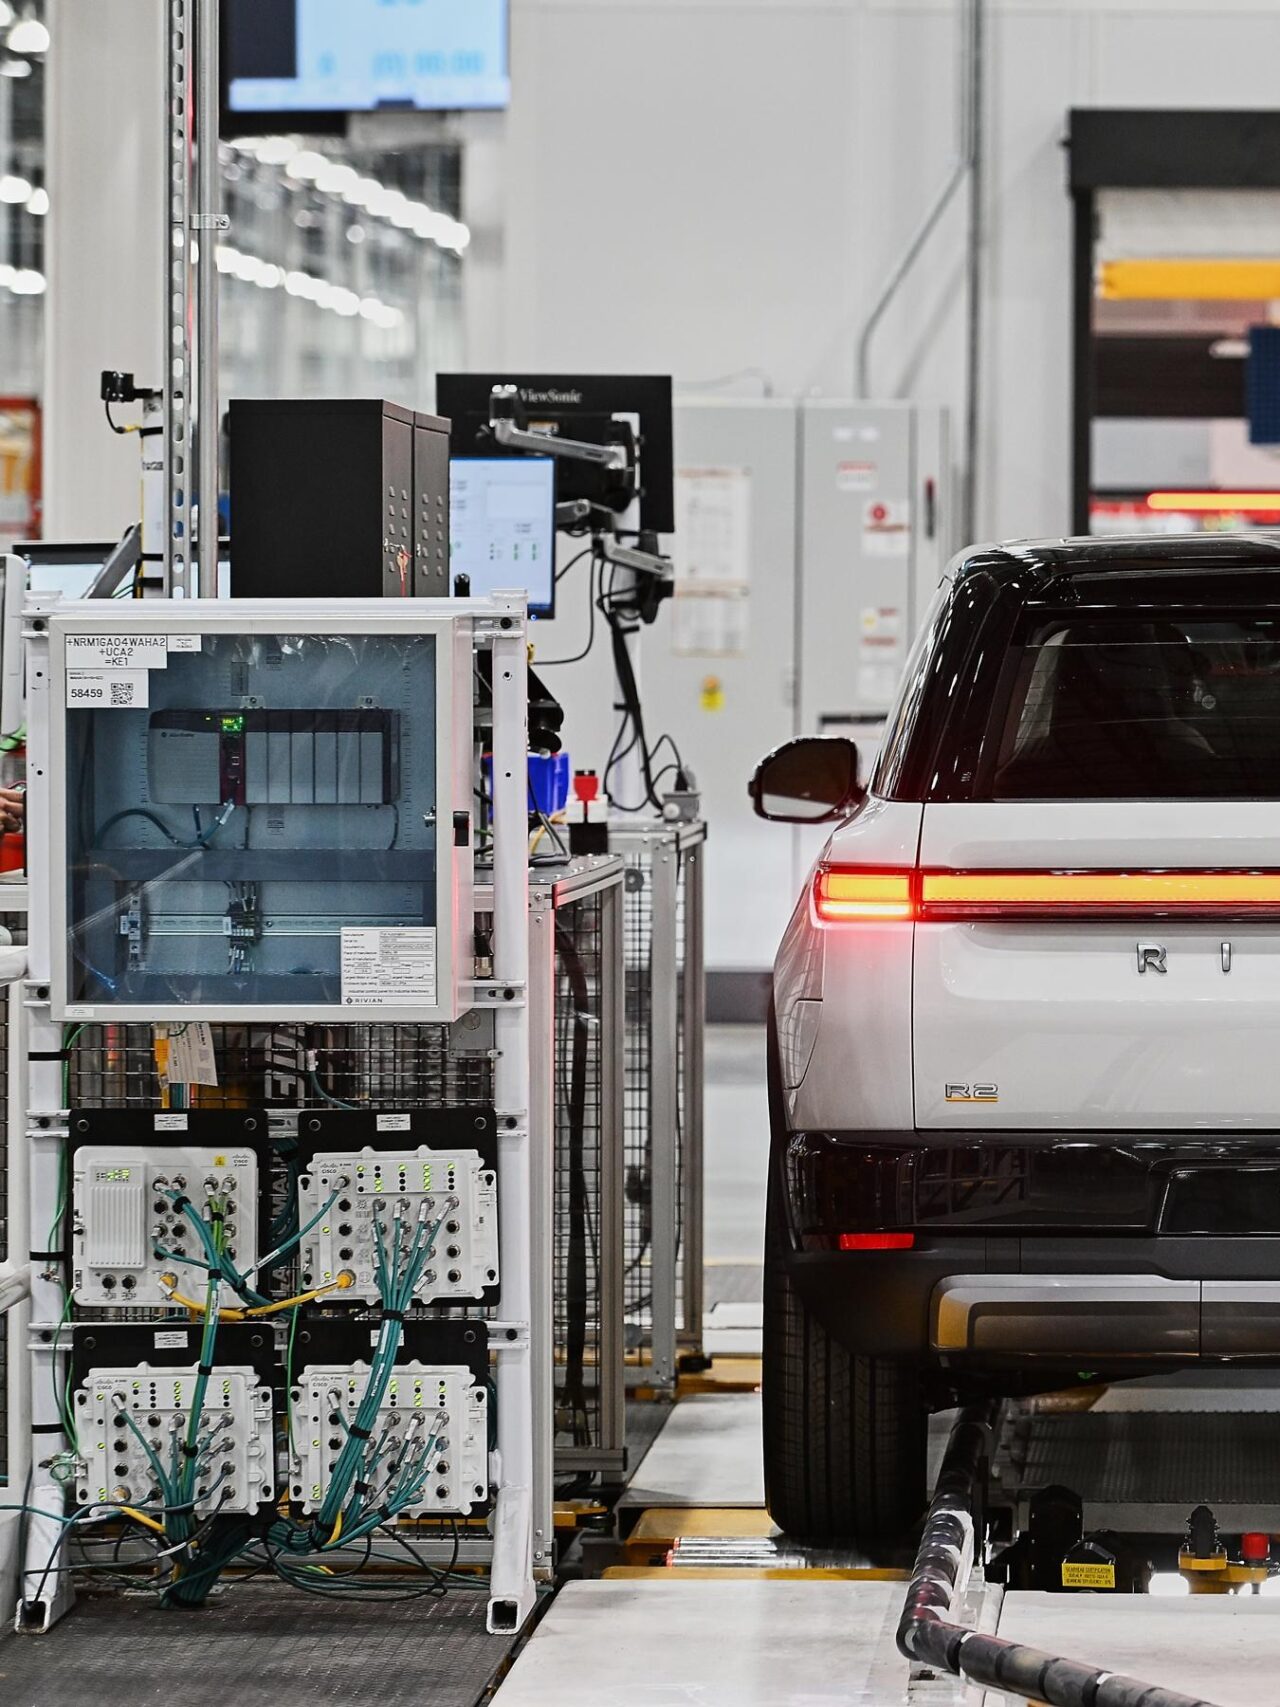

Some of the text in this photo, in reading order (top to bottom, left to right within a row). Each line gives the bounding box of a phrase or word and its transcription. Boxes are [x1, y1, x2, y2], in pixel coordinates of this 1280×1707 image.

[520, 390, 582, 403] ViewSonic
[100, 648, 133, 657] +UCA2
[105, 657, 128, 666] =KE1
[71, 688, 103, 698] 58459
[945, 1083, 998, 1099] R2
